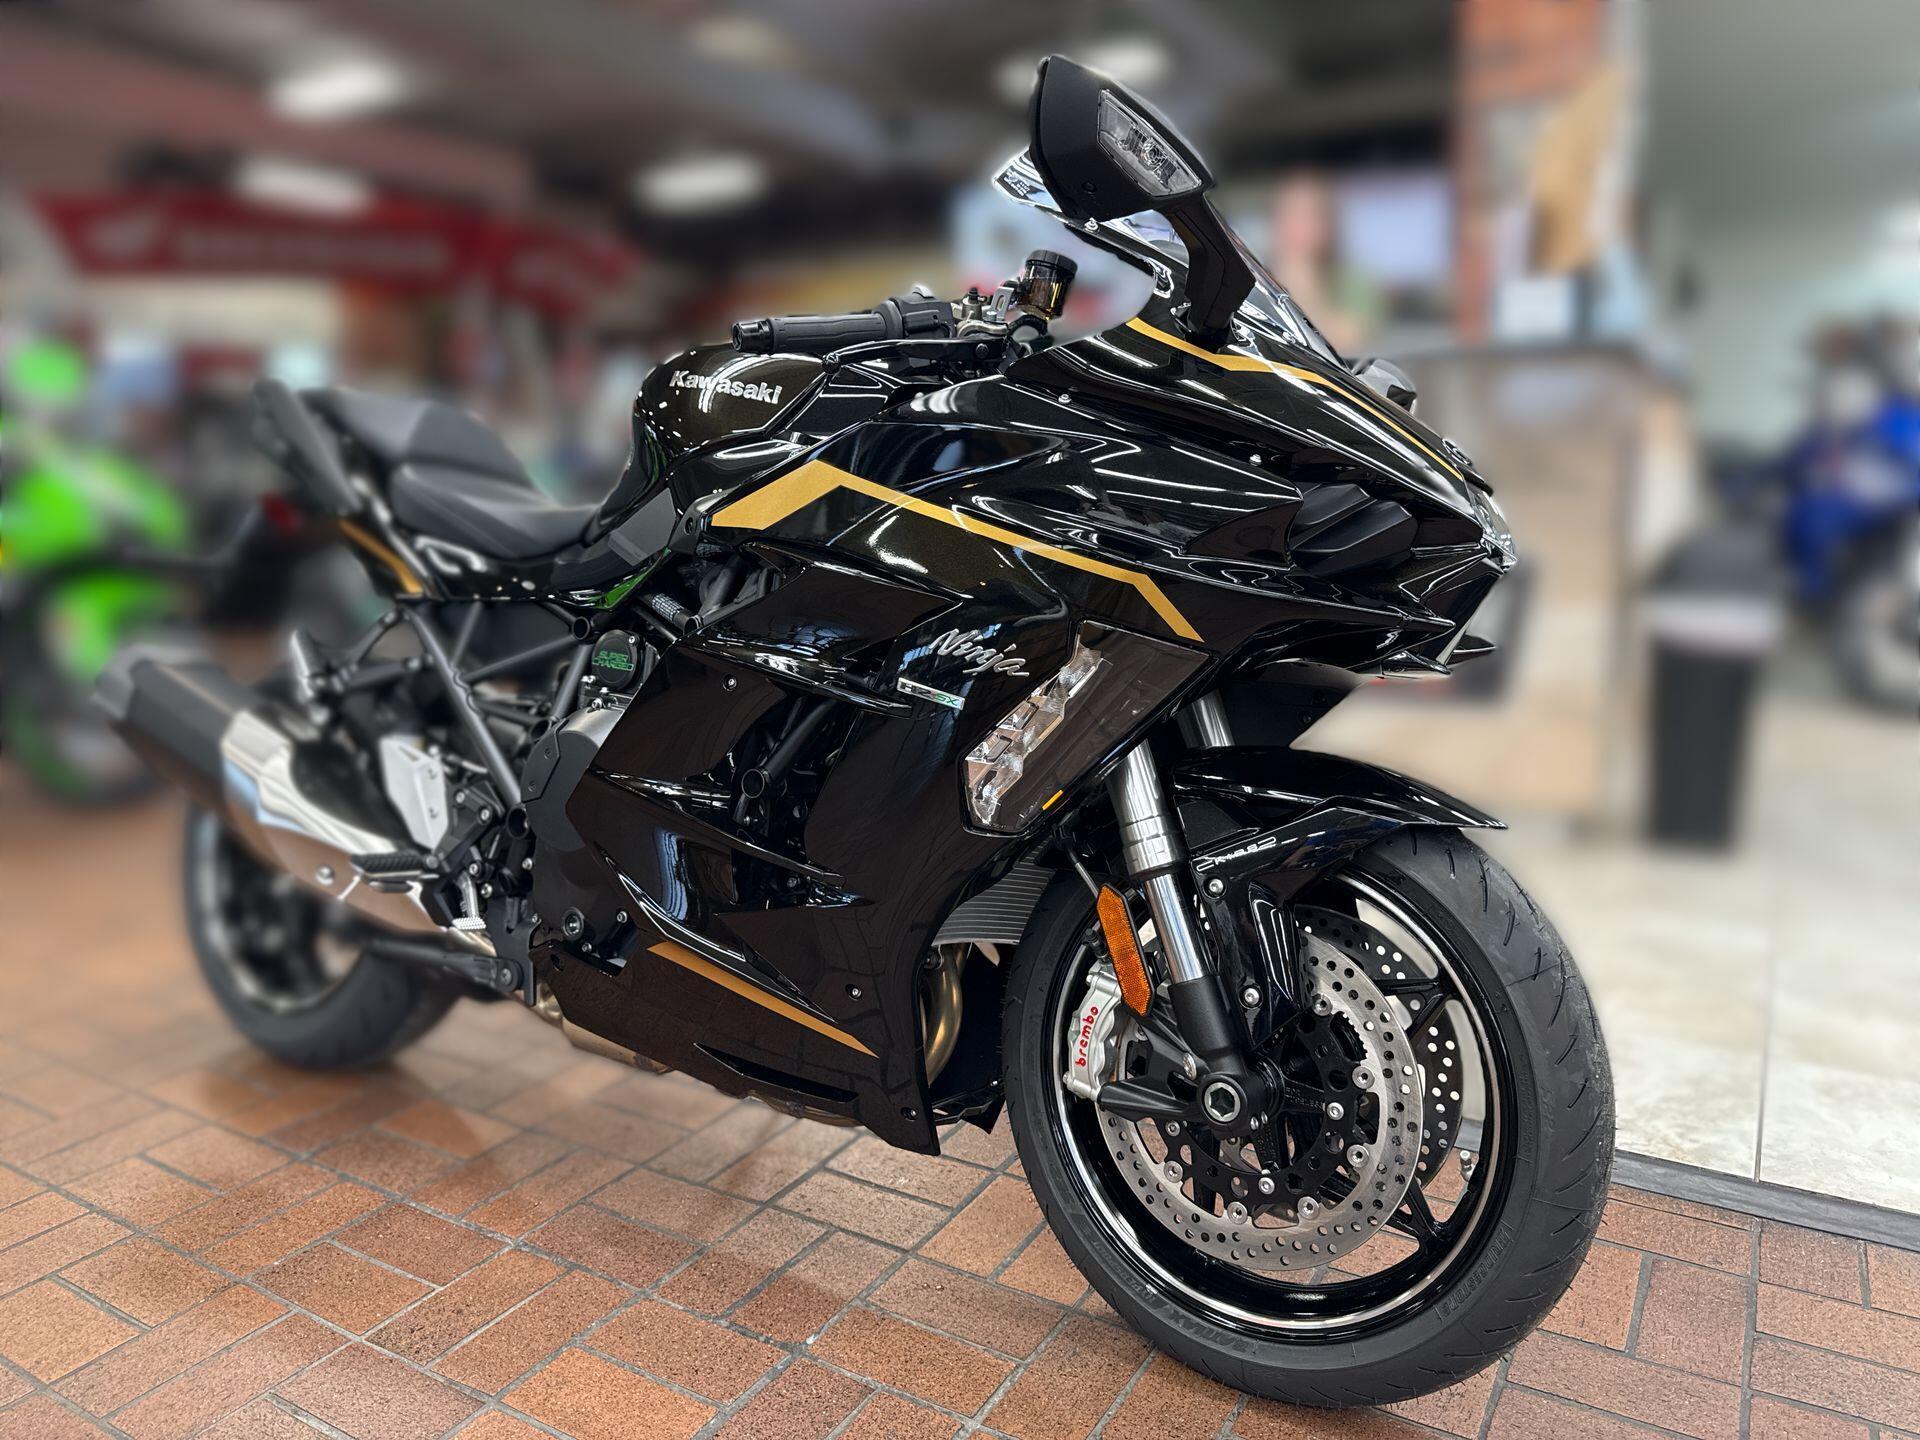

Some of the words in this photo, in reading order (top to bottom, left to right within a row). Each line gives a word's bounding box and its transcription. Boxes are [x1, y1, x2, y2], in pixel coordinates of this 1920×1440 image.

[669, 370, 783, 405] Kawasaki
[592, 657, 635, 671] CHARGED
[599, 651, 628, 663] SUPER
[928, 628, 1030, 677] Ninja
[1075, 1006, 1099, 1067] brembo
